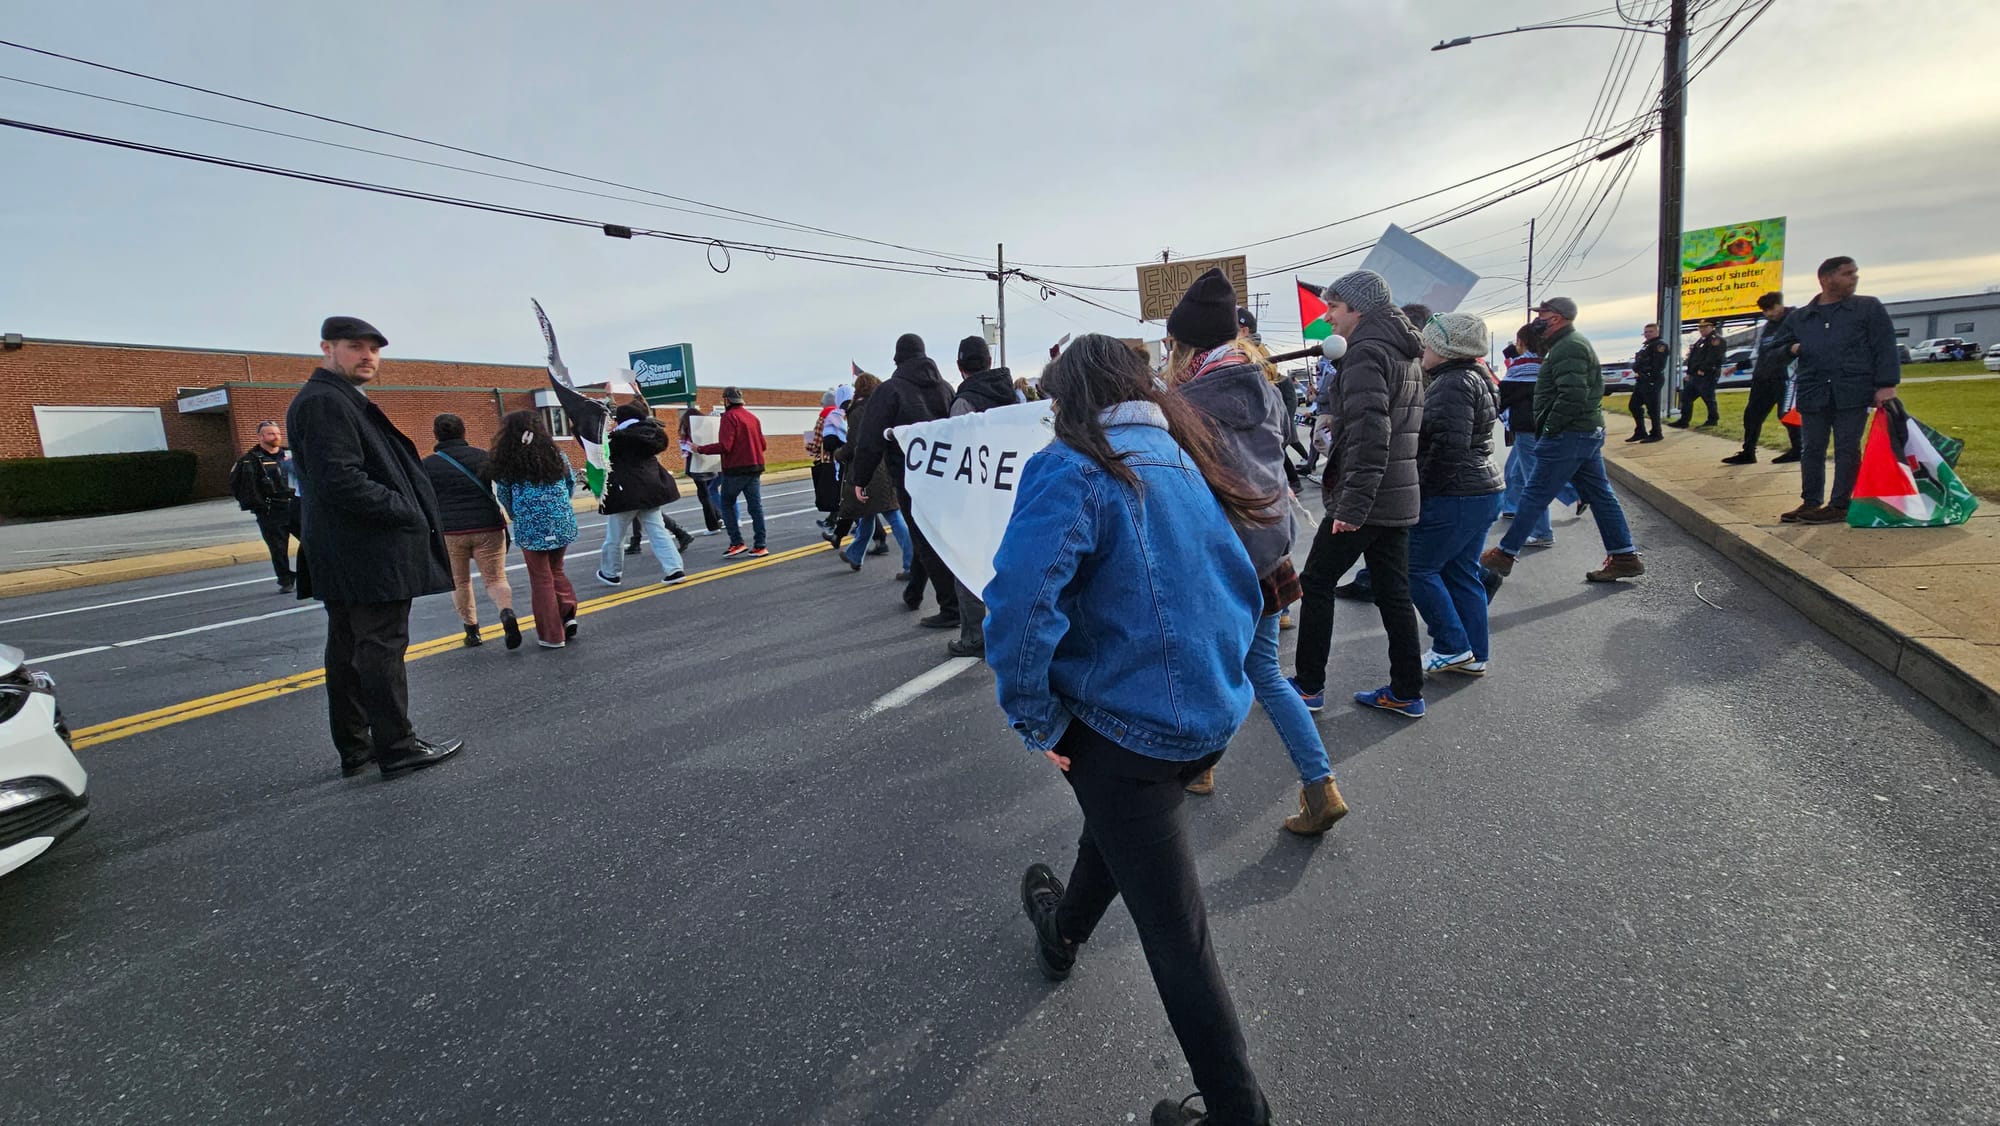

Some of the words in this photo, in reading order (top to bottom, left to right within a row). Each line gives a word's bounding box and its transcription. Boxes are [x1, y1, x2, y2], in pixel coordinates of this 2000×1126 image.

[1143, 264, 1193, 297] END
[1716, 272, 1726, 281] of
[1729, 269, 1765, 280] shelter
[1699, 283, 1723, 295] need
[648, 363, 672, 373] Steve
[647, 370, 682, 382] Shannon
[905, 437, 1018, 491] CEASE
